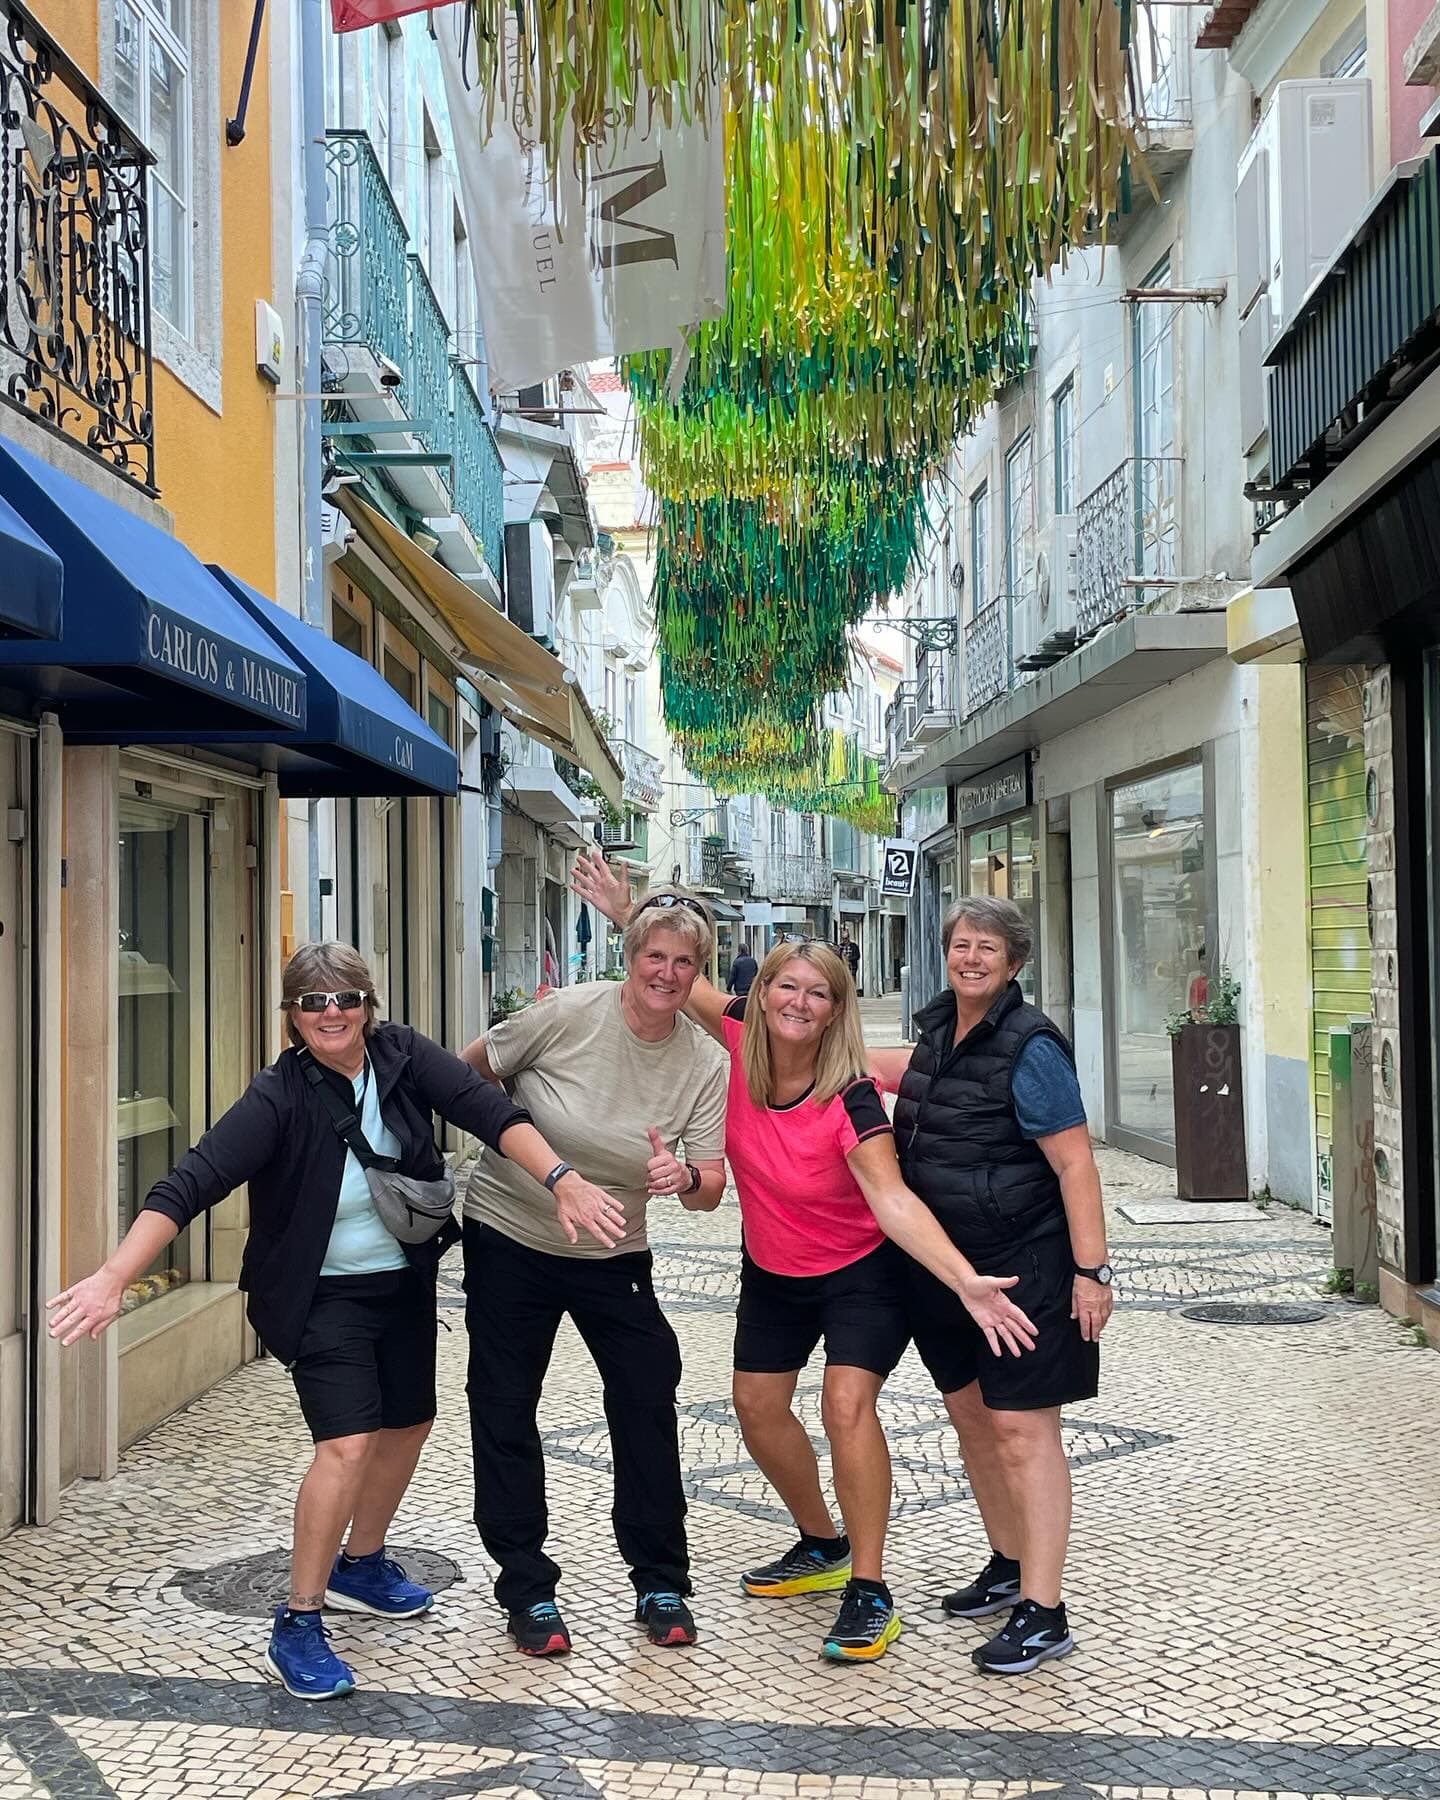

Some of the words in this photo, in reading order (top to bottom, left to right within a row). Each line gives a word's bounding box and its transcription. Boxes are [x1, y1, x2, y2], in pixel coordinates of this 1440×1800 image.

[149, 614, 218, 684] CARLOS
[225, 660, 235, 691] &
[242, 657, 301, 719] MANUEL
